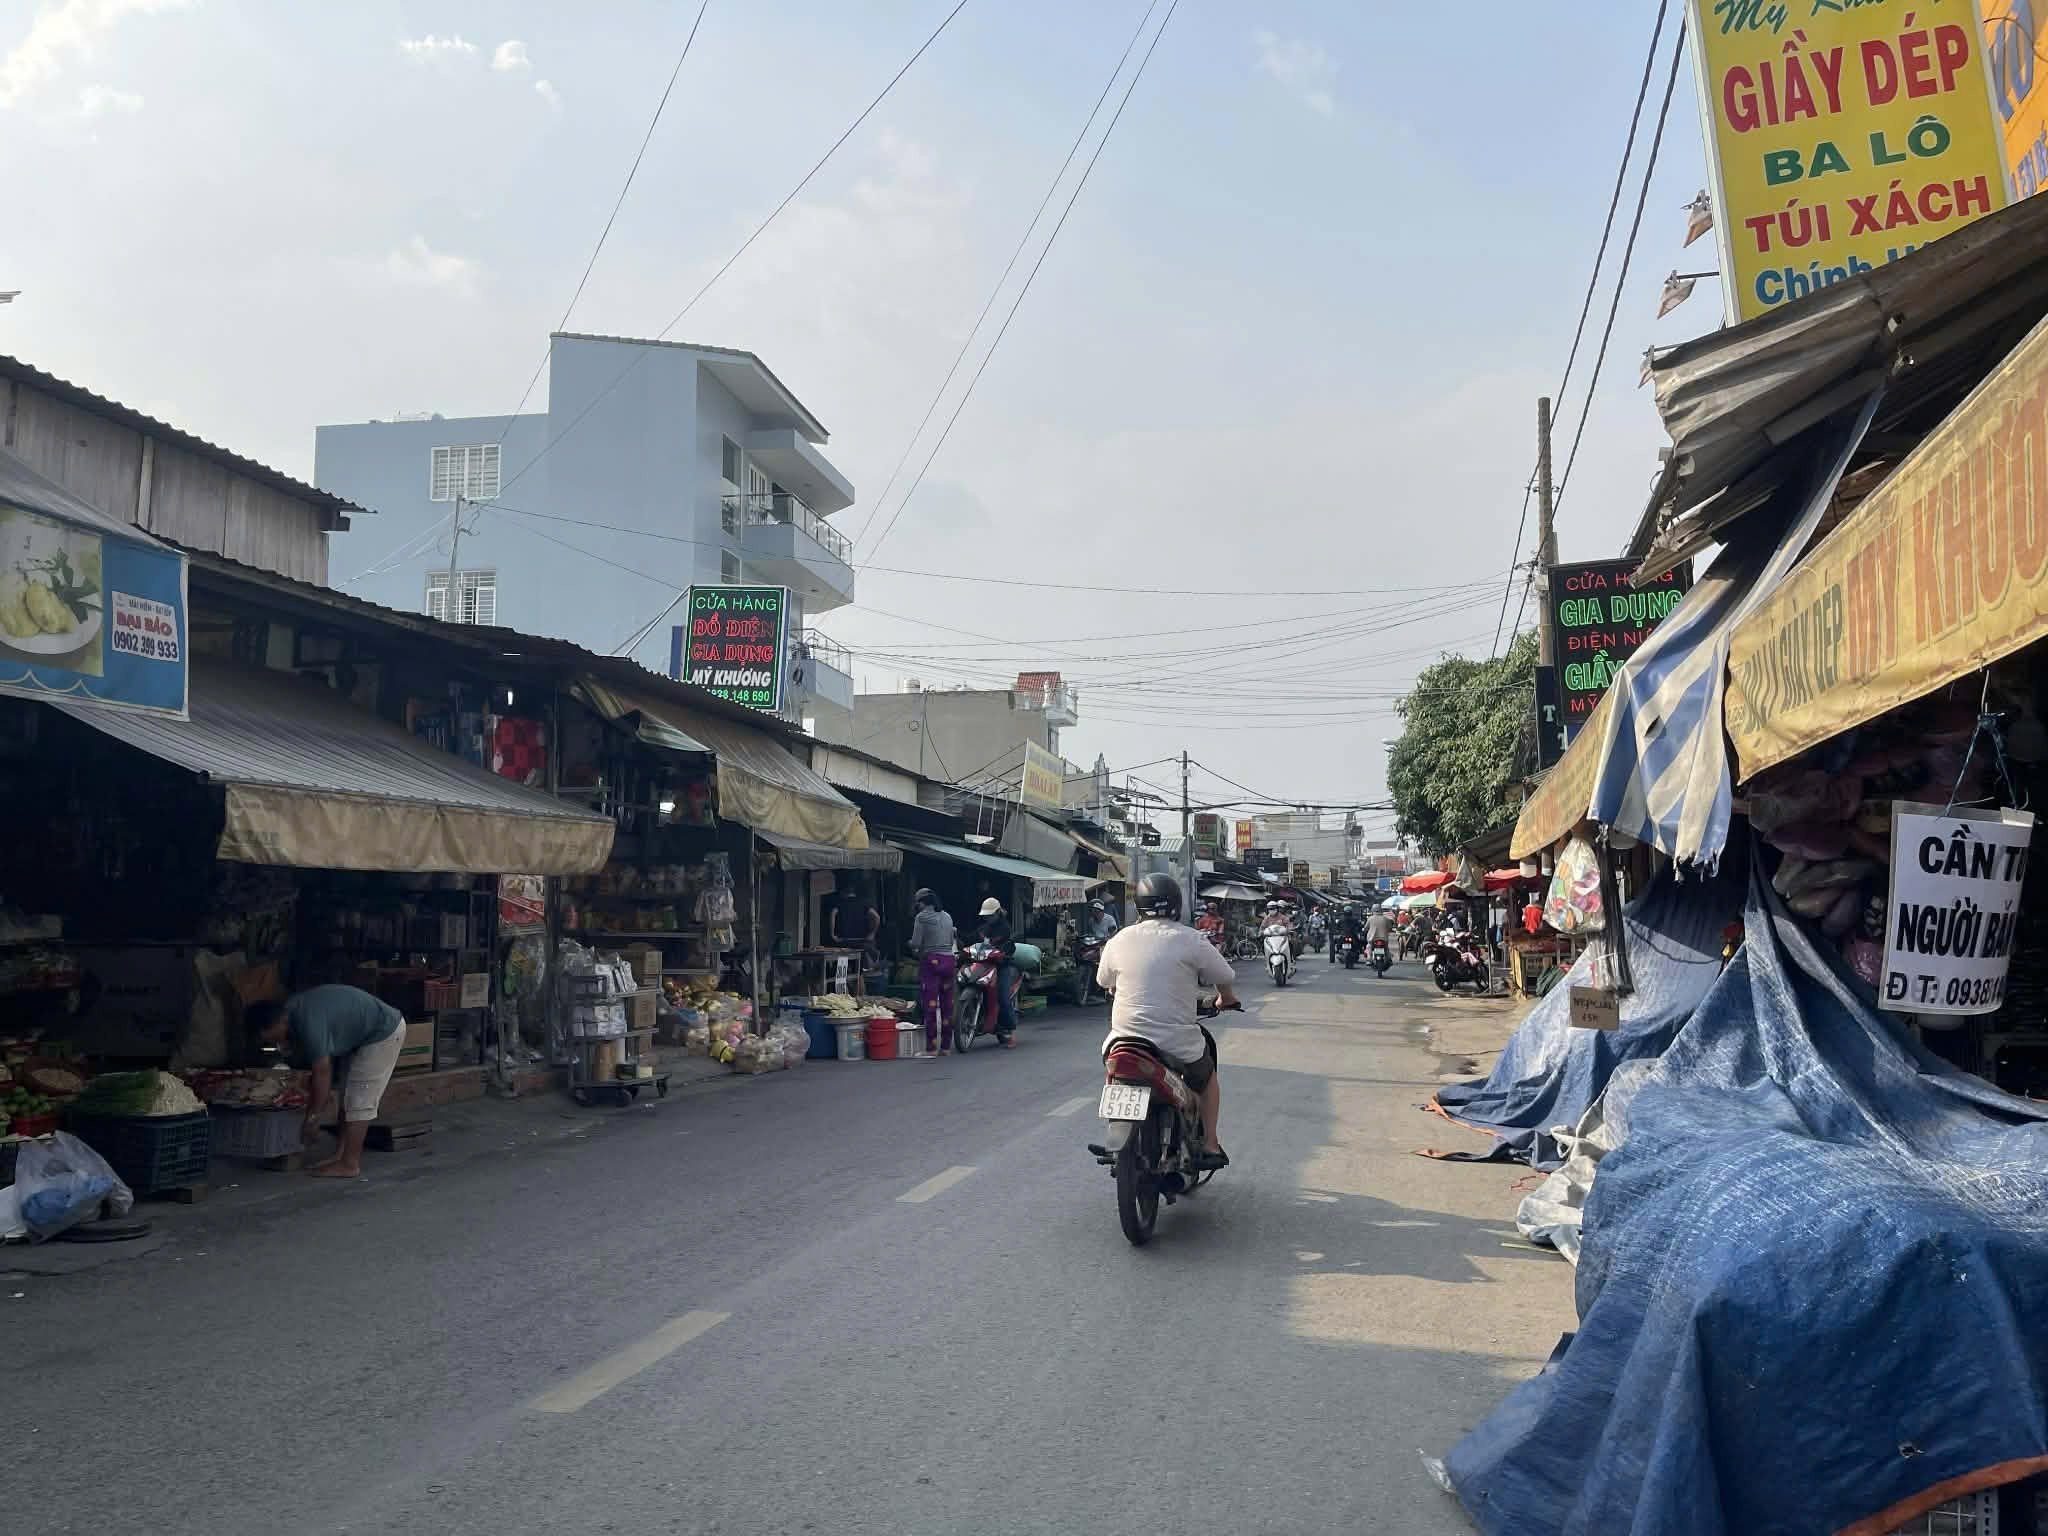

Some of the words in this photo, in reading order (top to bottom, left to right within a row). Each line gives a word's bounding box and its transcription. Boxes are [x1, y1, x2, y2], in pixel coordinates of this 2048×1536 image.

[1723, 29, 1844, 133] GIẦY
[1860, 12, 1970, 106] DÉP
[1763, 141, 1851, 186] BA
[1869, 114, 1951, 166] LÔ
[1745, 198, 1831, 252] TÚI
[1846, 175, 1992, 237] XÁCH
[695, 592, 727, 609] CỬA
[732, 592, 777, 611] HÀNG
[1560, 598, 1603, 627] GIA
[1611, 589, 1683, 628] DỤNG
[113, 630, 139, 652] 0902
[158, 639, 178, 658] 933
[690, 642, 720, 661] GIA
[724, 644, 774, 667] DỤNG
[691, 666, 713, 685] MỸ
[732, 690, 750, 701] 148
[752, 690, 770, 702] 690
[1918, 823, 1996, 880] CẦN
[1896, 897, 1982, 958] NGƯỜI
